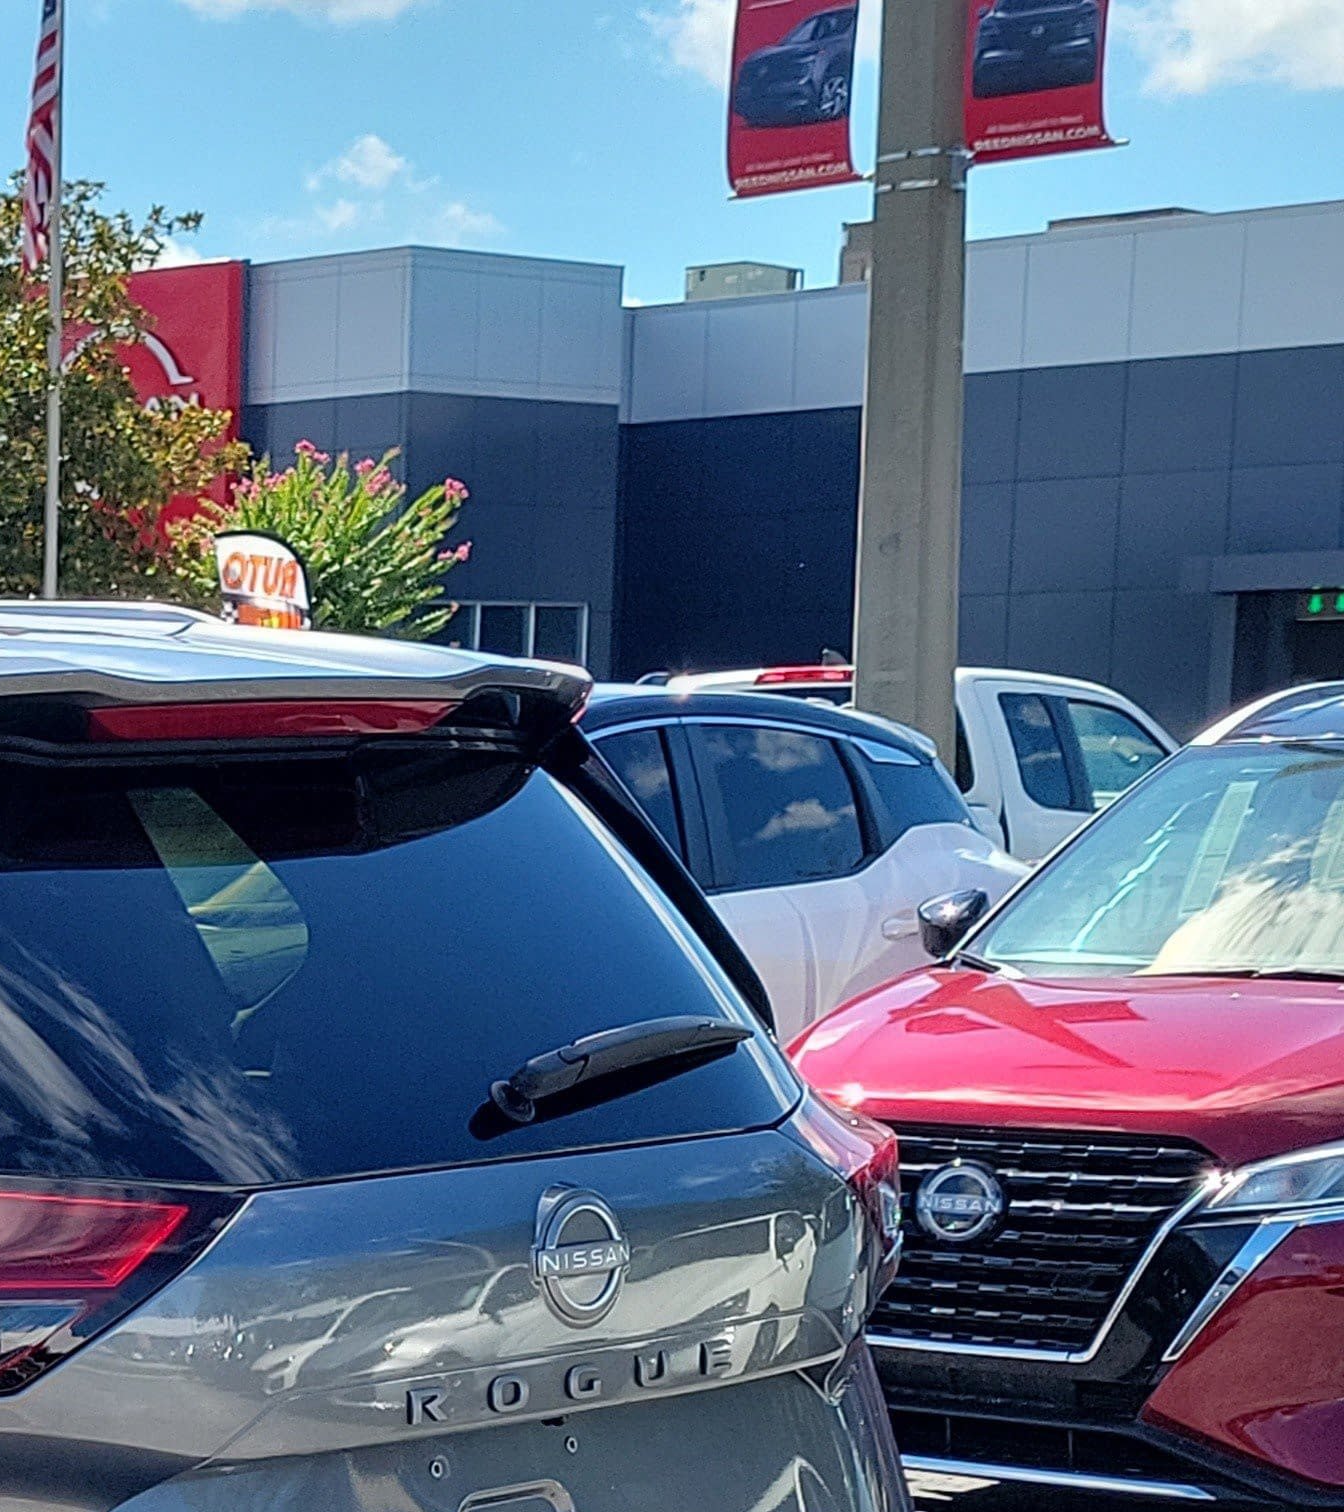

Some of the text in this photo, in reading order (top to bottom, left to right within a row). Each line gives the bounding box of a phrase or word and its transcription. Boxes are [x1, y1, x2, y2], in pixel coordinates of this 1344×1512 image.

[919, 1195, 1000, 1213] NISSAN
[542, 1245, 630, 1273] NISSAN
[407, 1341, 735, 1425] ROGUE
